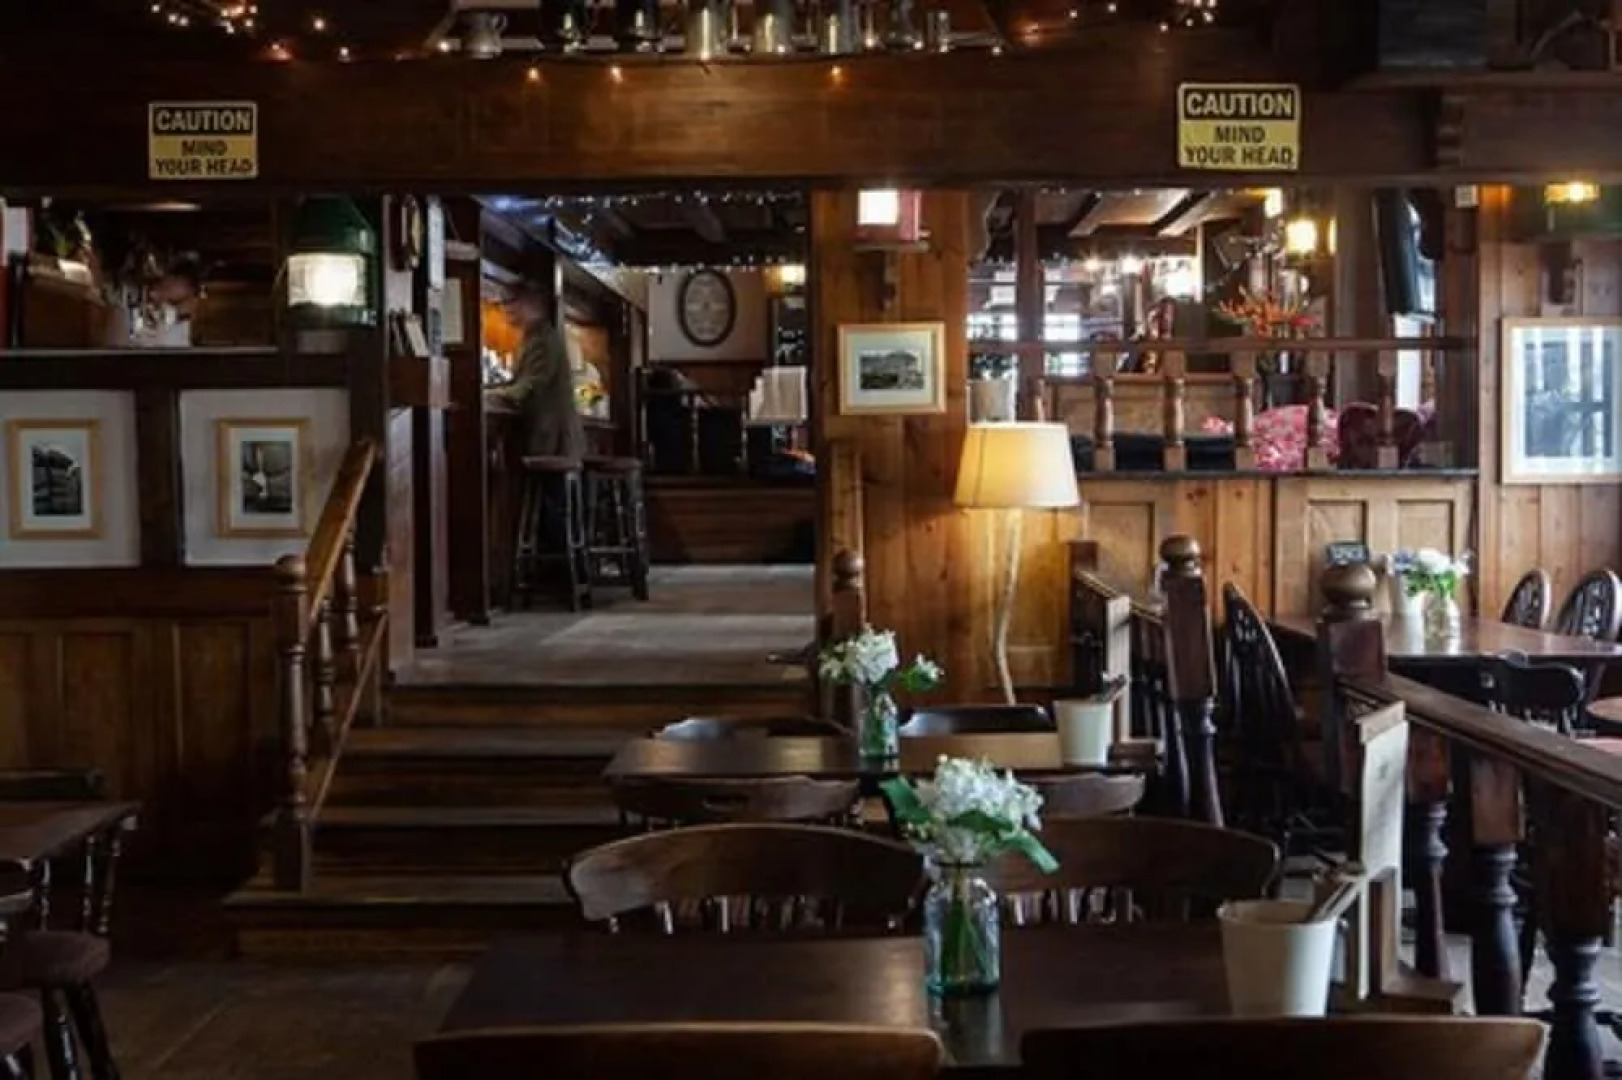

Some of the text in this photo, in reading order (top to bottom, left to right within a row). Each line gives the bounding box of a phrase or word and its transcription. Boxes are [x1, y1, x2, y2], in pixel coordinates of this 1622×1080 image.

[1186, 92, 1292, 116] CAUTION
[156, 109, 250, 131] CAUTION
[1214, 125, 1266, 143] MIND
[181, 139, 228, 157] MIND
[1184, 145, 1293, 164] YOUR HEAD
[155, 158, 252, 176] YOUR HEAD
